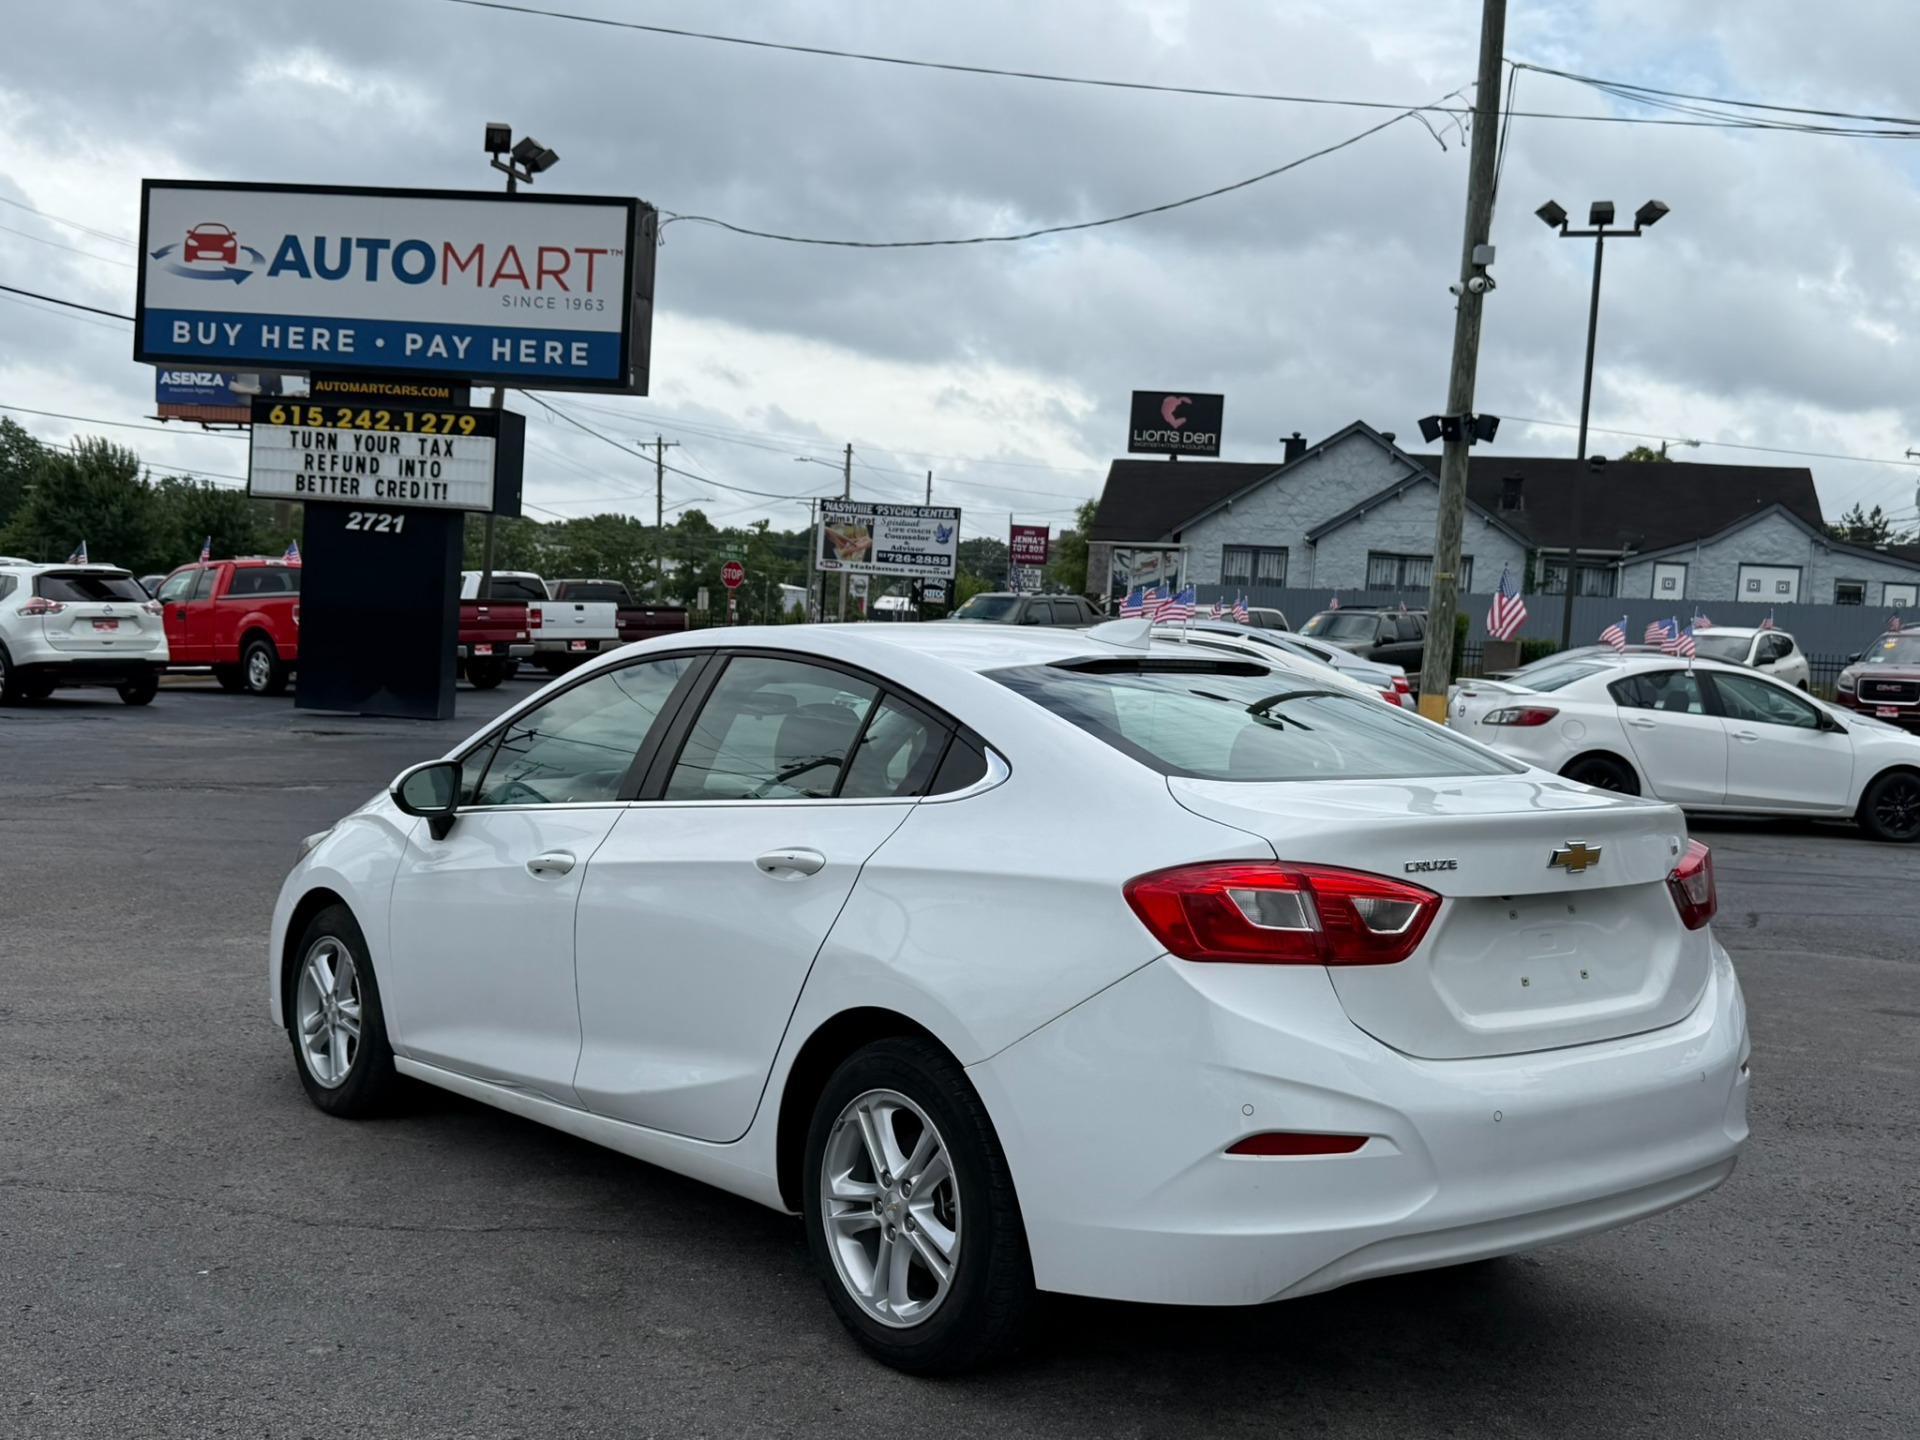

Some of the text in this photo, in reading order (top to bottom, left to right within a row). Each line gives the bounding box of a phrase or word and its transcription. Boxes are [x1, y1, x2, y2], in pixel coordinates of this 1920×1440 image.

[266, 234, 608, 293] AUTOMART
[502, 295, 605, 312] SINCE 1963
[172, 320, 589, 366] BUY HERE PAY HERE
[160, 371, 225, 387] ASENZA
[315, 380, 450, 398] AUTOMARTCARS.COM
[269, 405, 477, 435] 615.242.1279
[290, 430, 454, 458] TURN YOUR TAX
[304, 453, 442, 478] REFUND INTO
[295, 474, 449, 500] BETTER CREDIT!
[875, 504, 918, 517] PSYCHIC
[919, 507, 956, 519] CENTER
[345, 511, 405, 534] 2721
[1012, 535, 1046, 546] JENNA'S
[1012, 544, 1028, 552] TOY
[887, 553, 949, 566] 726-2882
[723, 568, 743, 579] STOP
[1876, 684, 1902, 692] GMC
[1404, 858, 1458, 873] CRUZE
